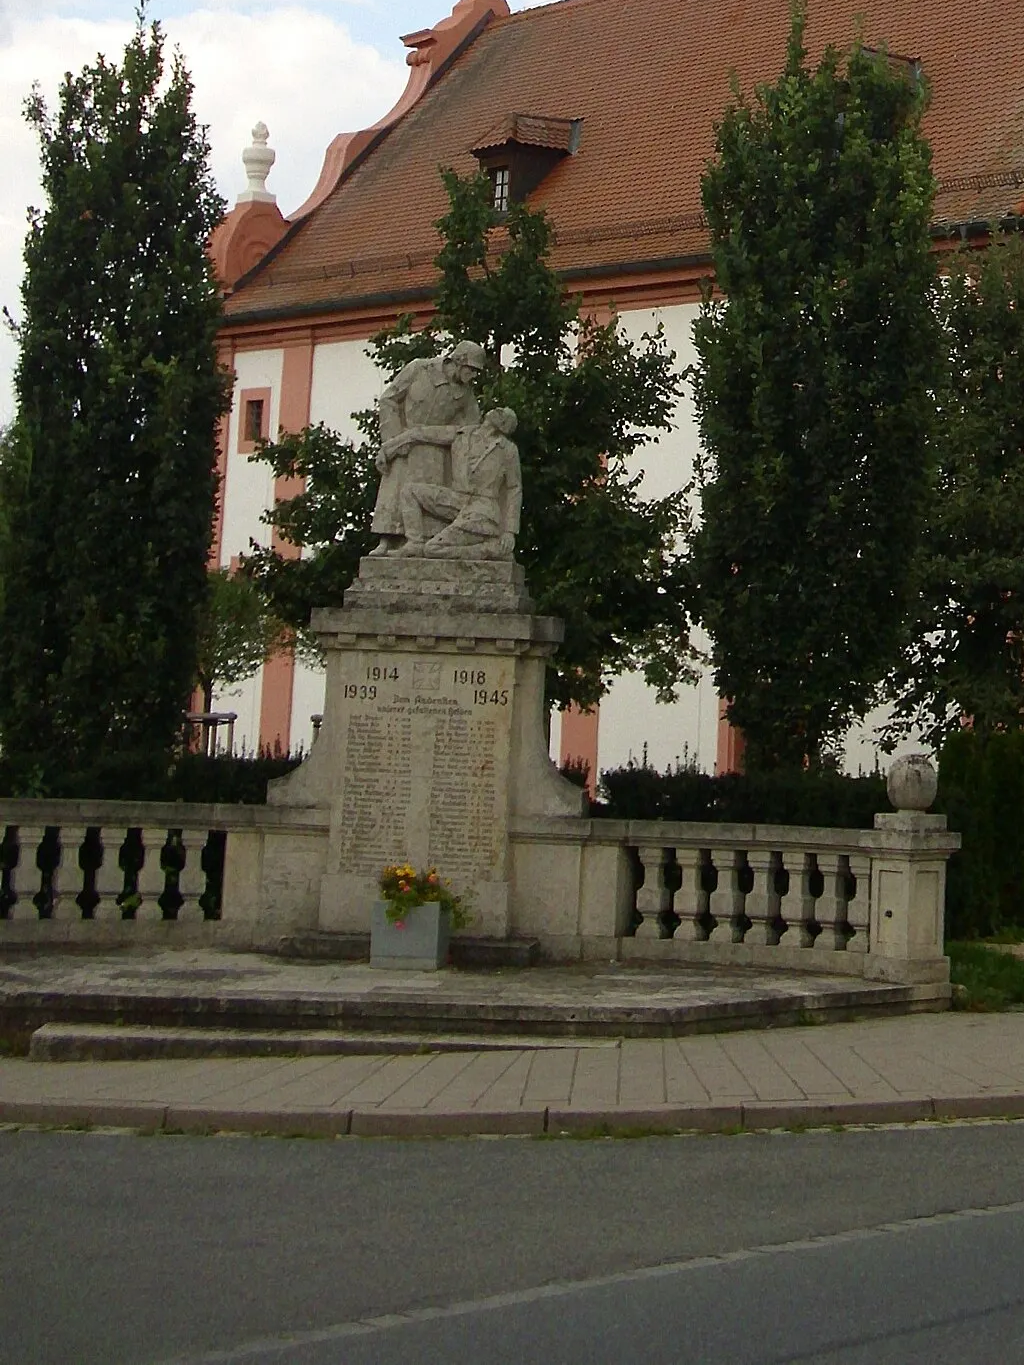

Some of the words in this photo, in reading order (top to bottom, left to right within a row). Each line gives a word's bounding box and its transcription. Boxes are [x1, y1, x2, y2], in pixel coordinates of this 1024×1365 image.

[366, 666, 400, 682] 1914
[453, 669, 487, 685] 1918
[343, 684, 378, 701] 1939
[473, 688, 509, 706] 1945
